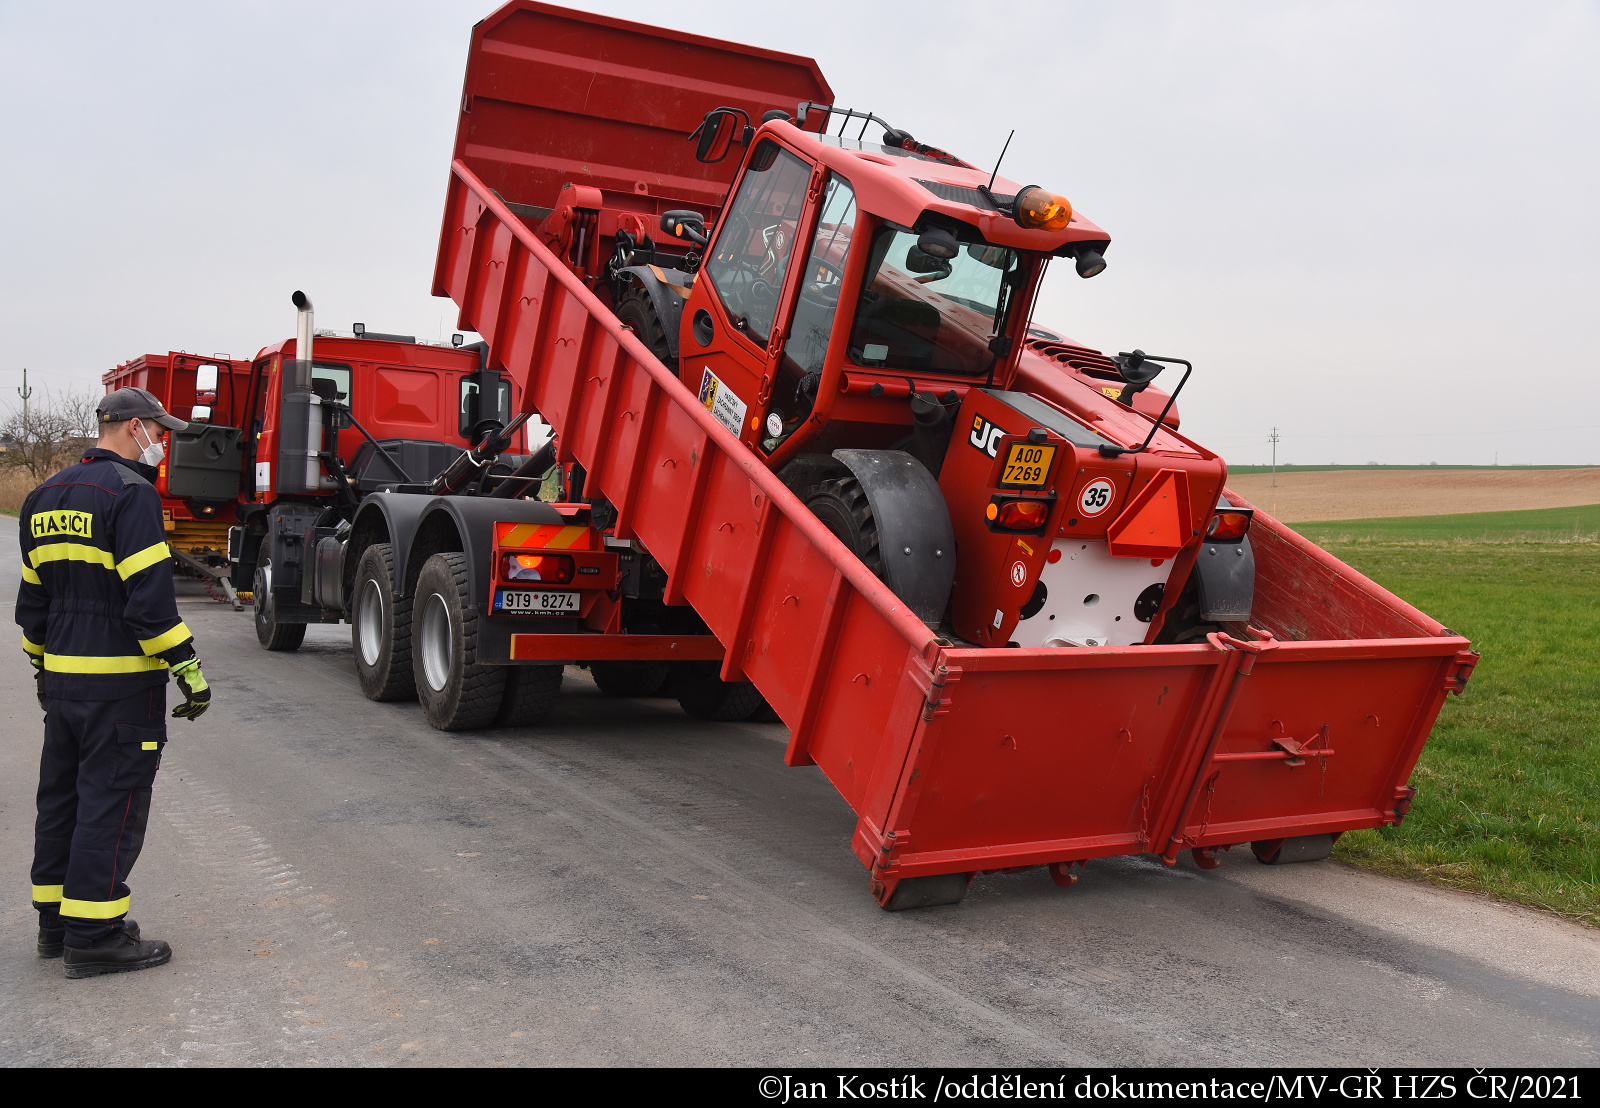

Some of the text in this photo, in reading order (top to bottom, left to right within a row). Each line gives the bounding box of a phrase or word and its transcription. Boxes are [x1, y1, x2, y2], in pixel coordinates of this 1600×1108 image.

[971, 421, 1005, 458] JC
[1004, 465, 1042, 482] 7269
[1084, 487, 1109, 507] 35
[33, 512, 88, 535] HASIČI
[505, 592, 531, 608] 9T9
[541, 594, 574, 609] 8274
